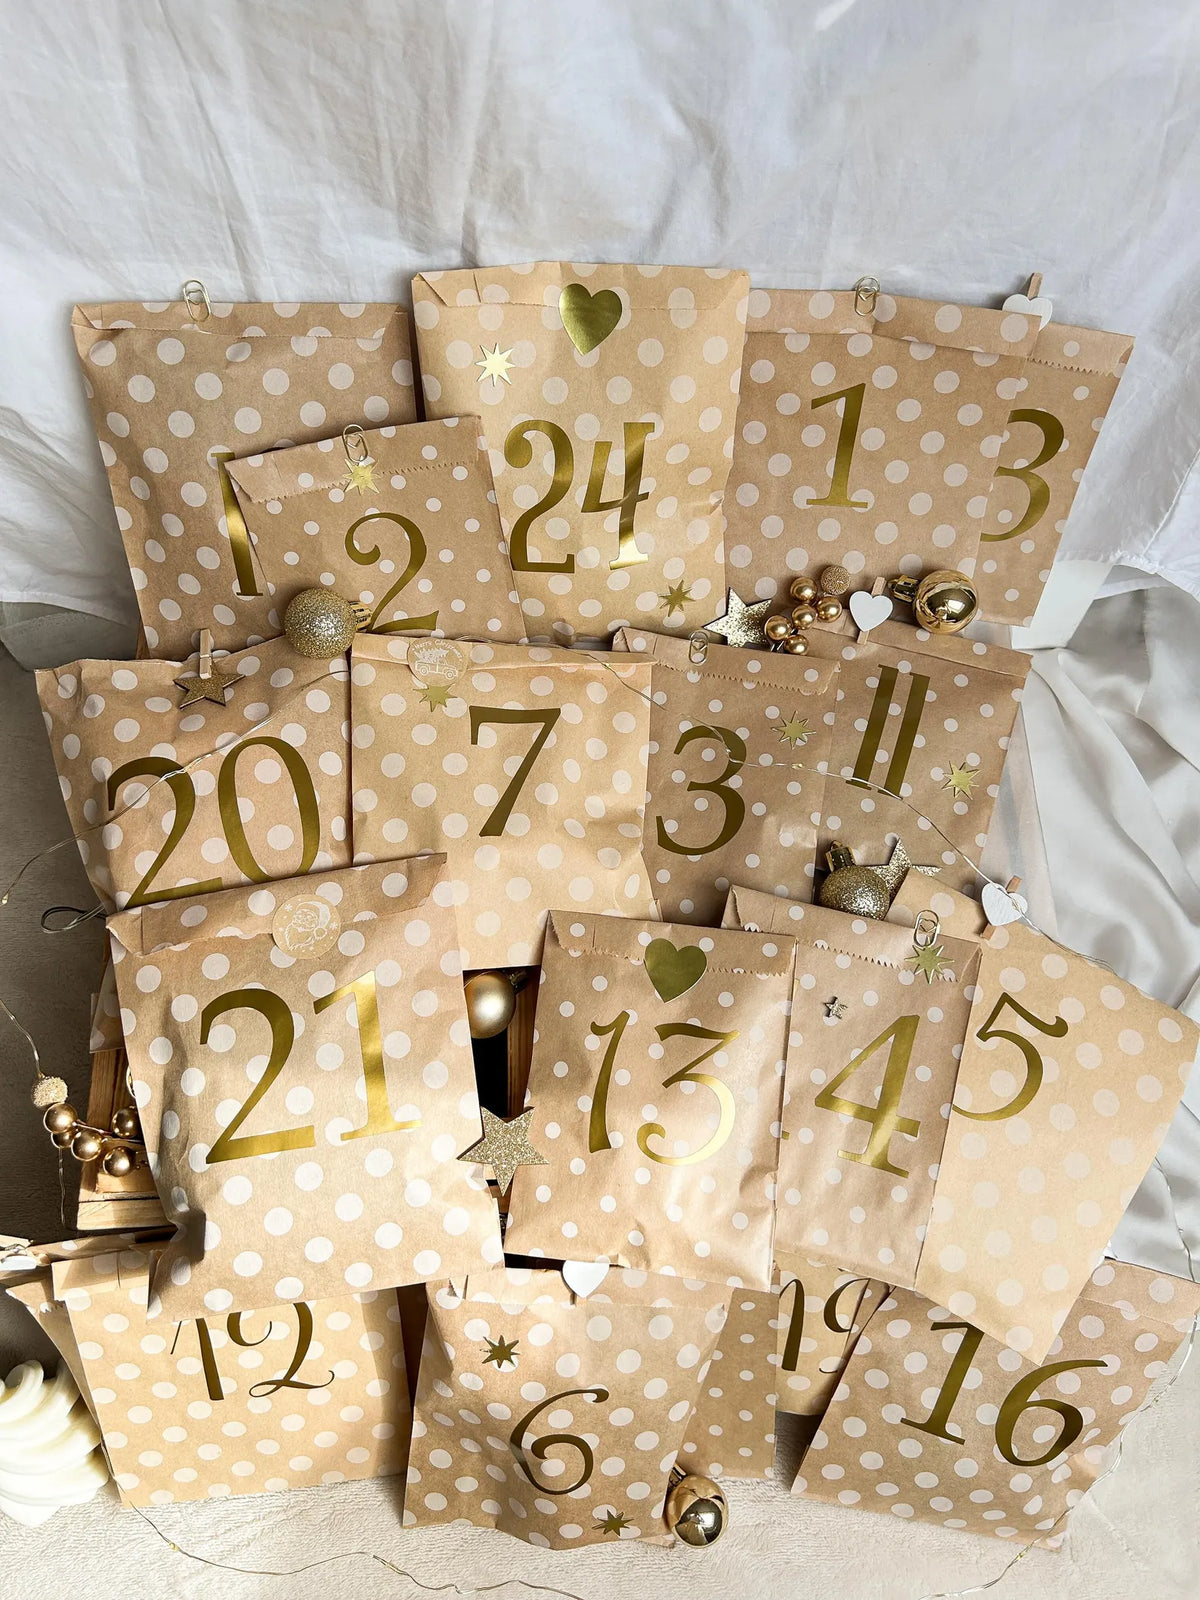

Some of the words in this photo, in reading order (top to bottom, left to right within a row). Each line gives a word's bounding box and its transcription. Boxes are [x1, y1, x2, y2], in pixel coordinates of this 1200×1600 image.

[504, 419, 655, 574] 24
[806, 382, 868, 509] 1
[344, 512, 440, 634] 2
[107, 736, 321, 908] 20
[468, 705, 562, 837] 7
[656, 725, 748, 856] 3
[200, 970, 422, 1164] 21
[589, 1010, 740, 1167] 13
[952, 992, 1068, 1121] 5
[170, 1302, 335, 1401] 12
[900, 1322, 1108, 1467] 16
[510, 1388, 610, 1495] 6
